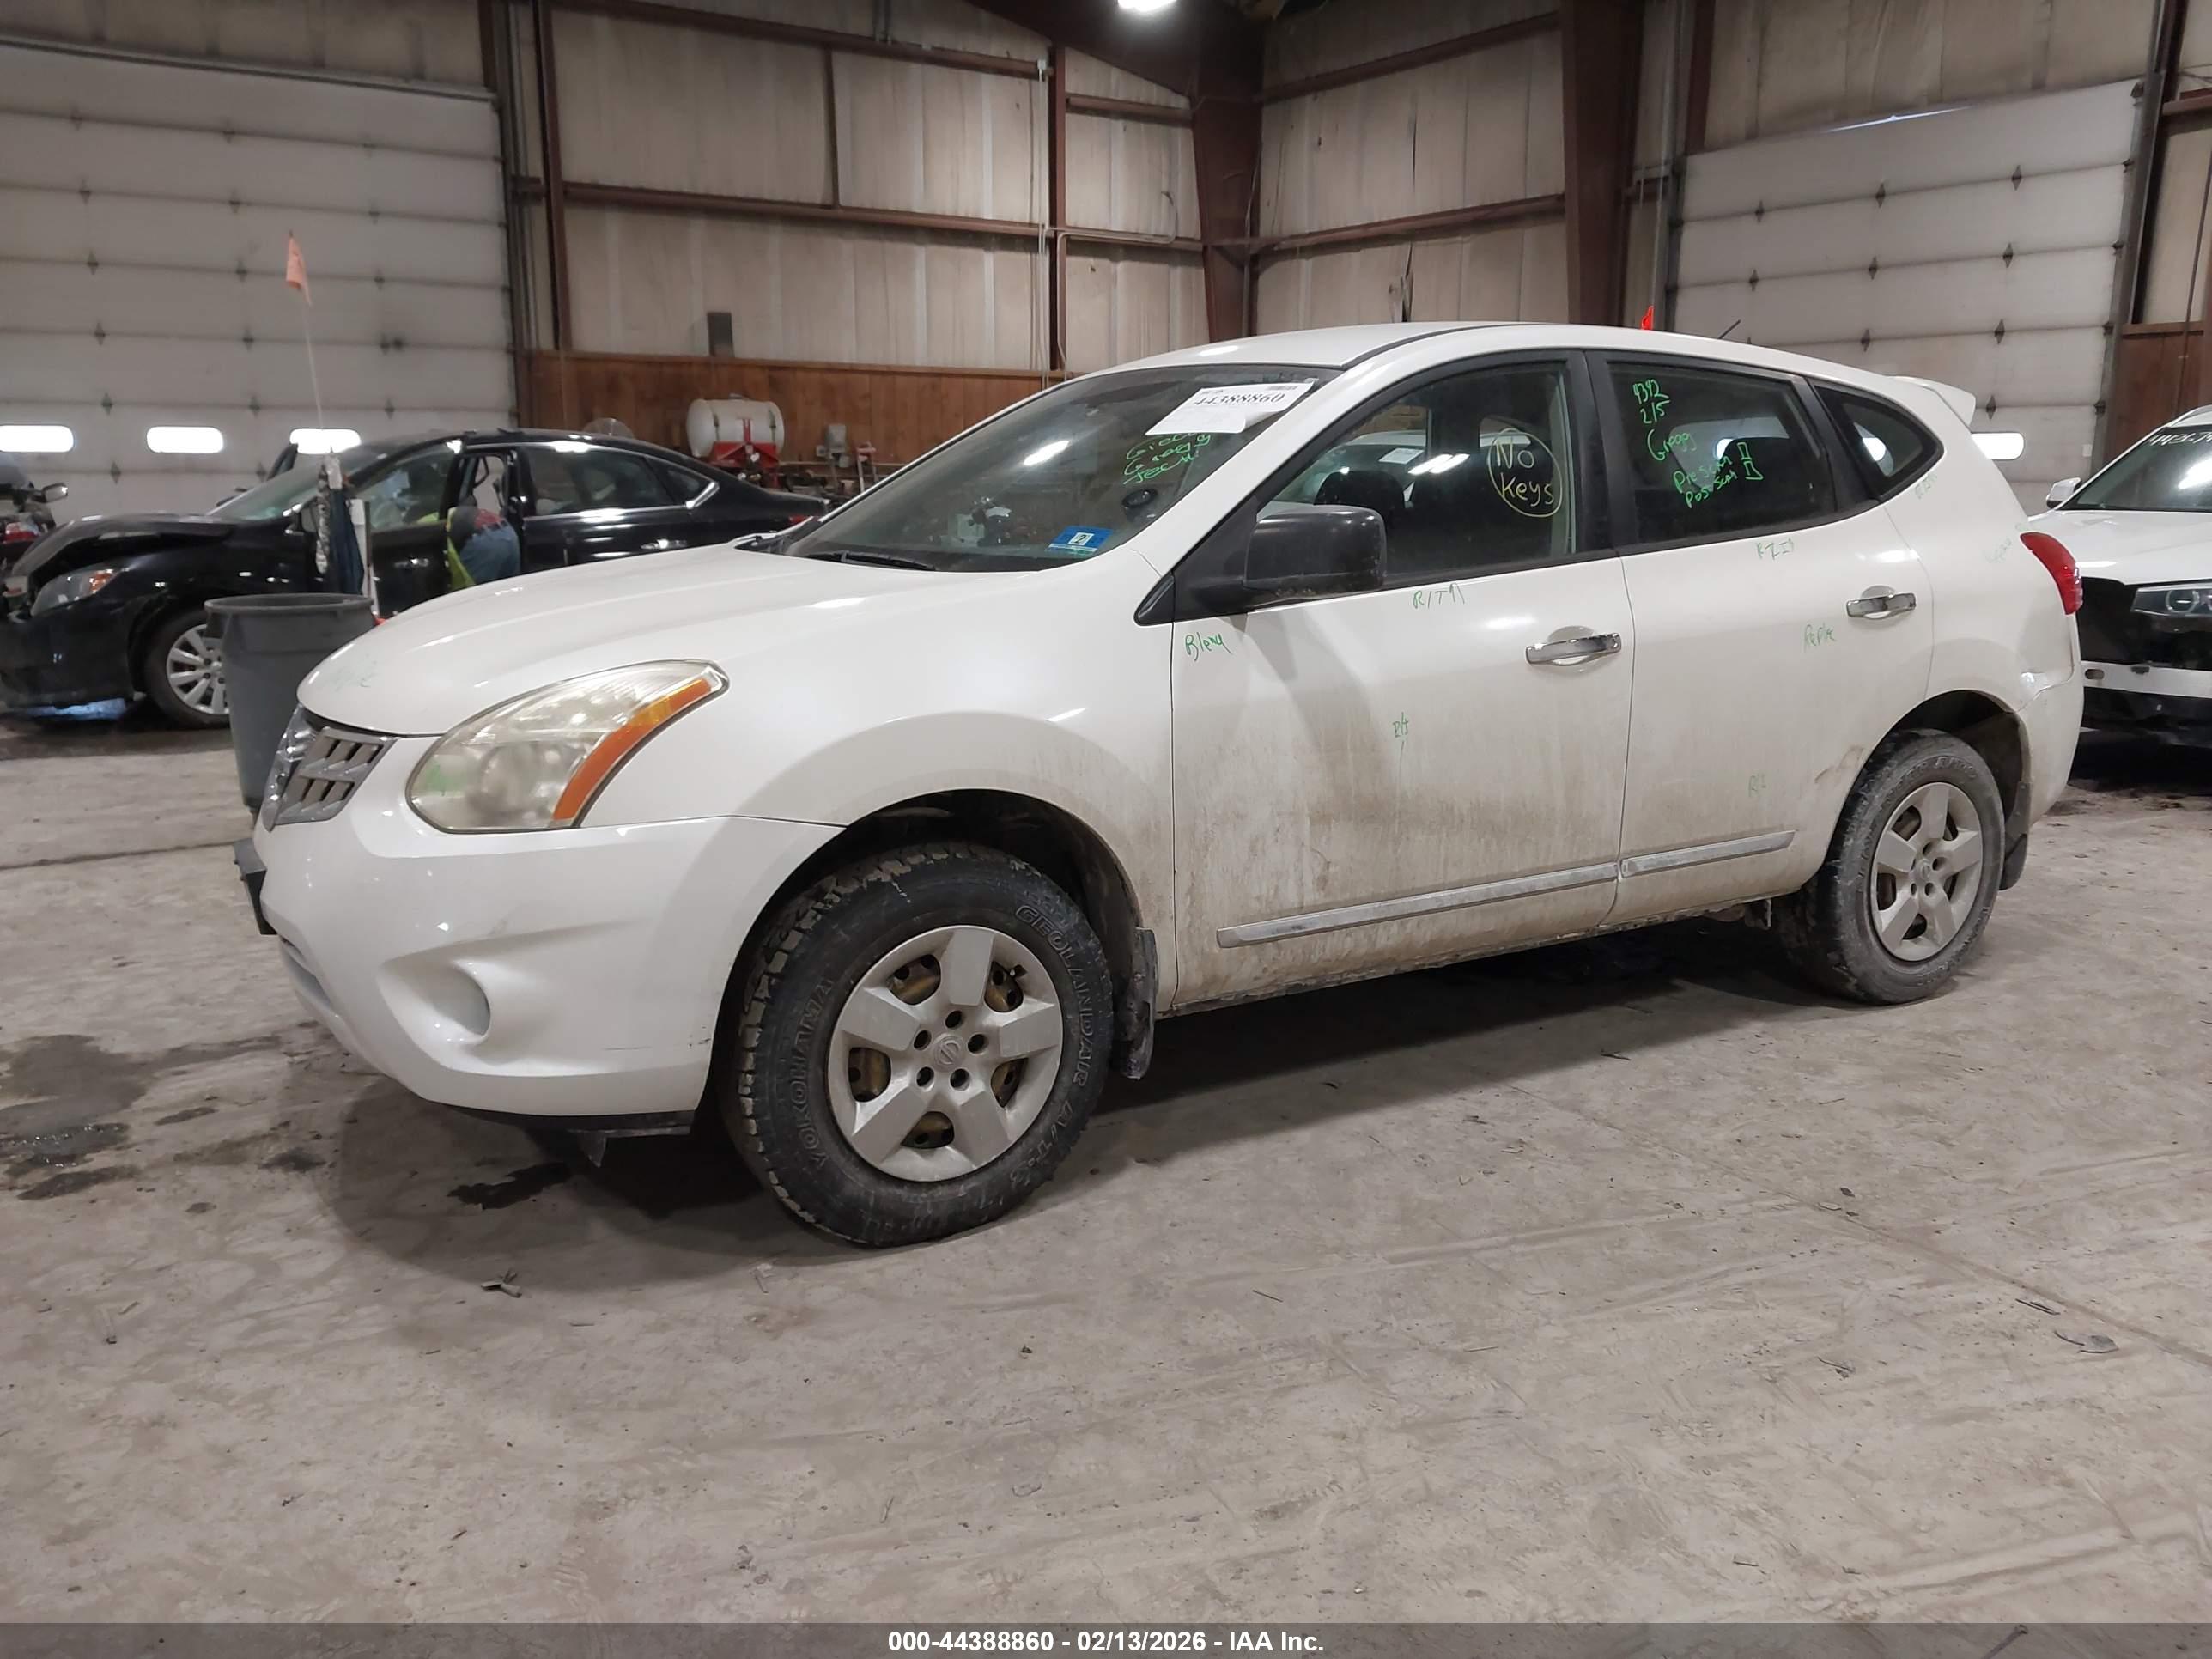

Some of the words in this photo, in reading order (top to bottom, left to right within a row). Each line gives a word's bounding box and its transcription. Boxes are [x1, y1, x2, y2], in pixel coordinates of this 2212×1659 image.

[1194, 393, 1285, 405] 44388860
[1495, 437, 1534, 469] No
[1015, 904, 1093, 1087] GEOLANDAR
[789, 979, 834, 1167] YOKOHAMA
